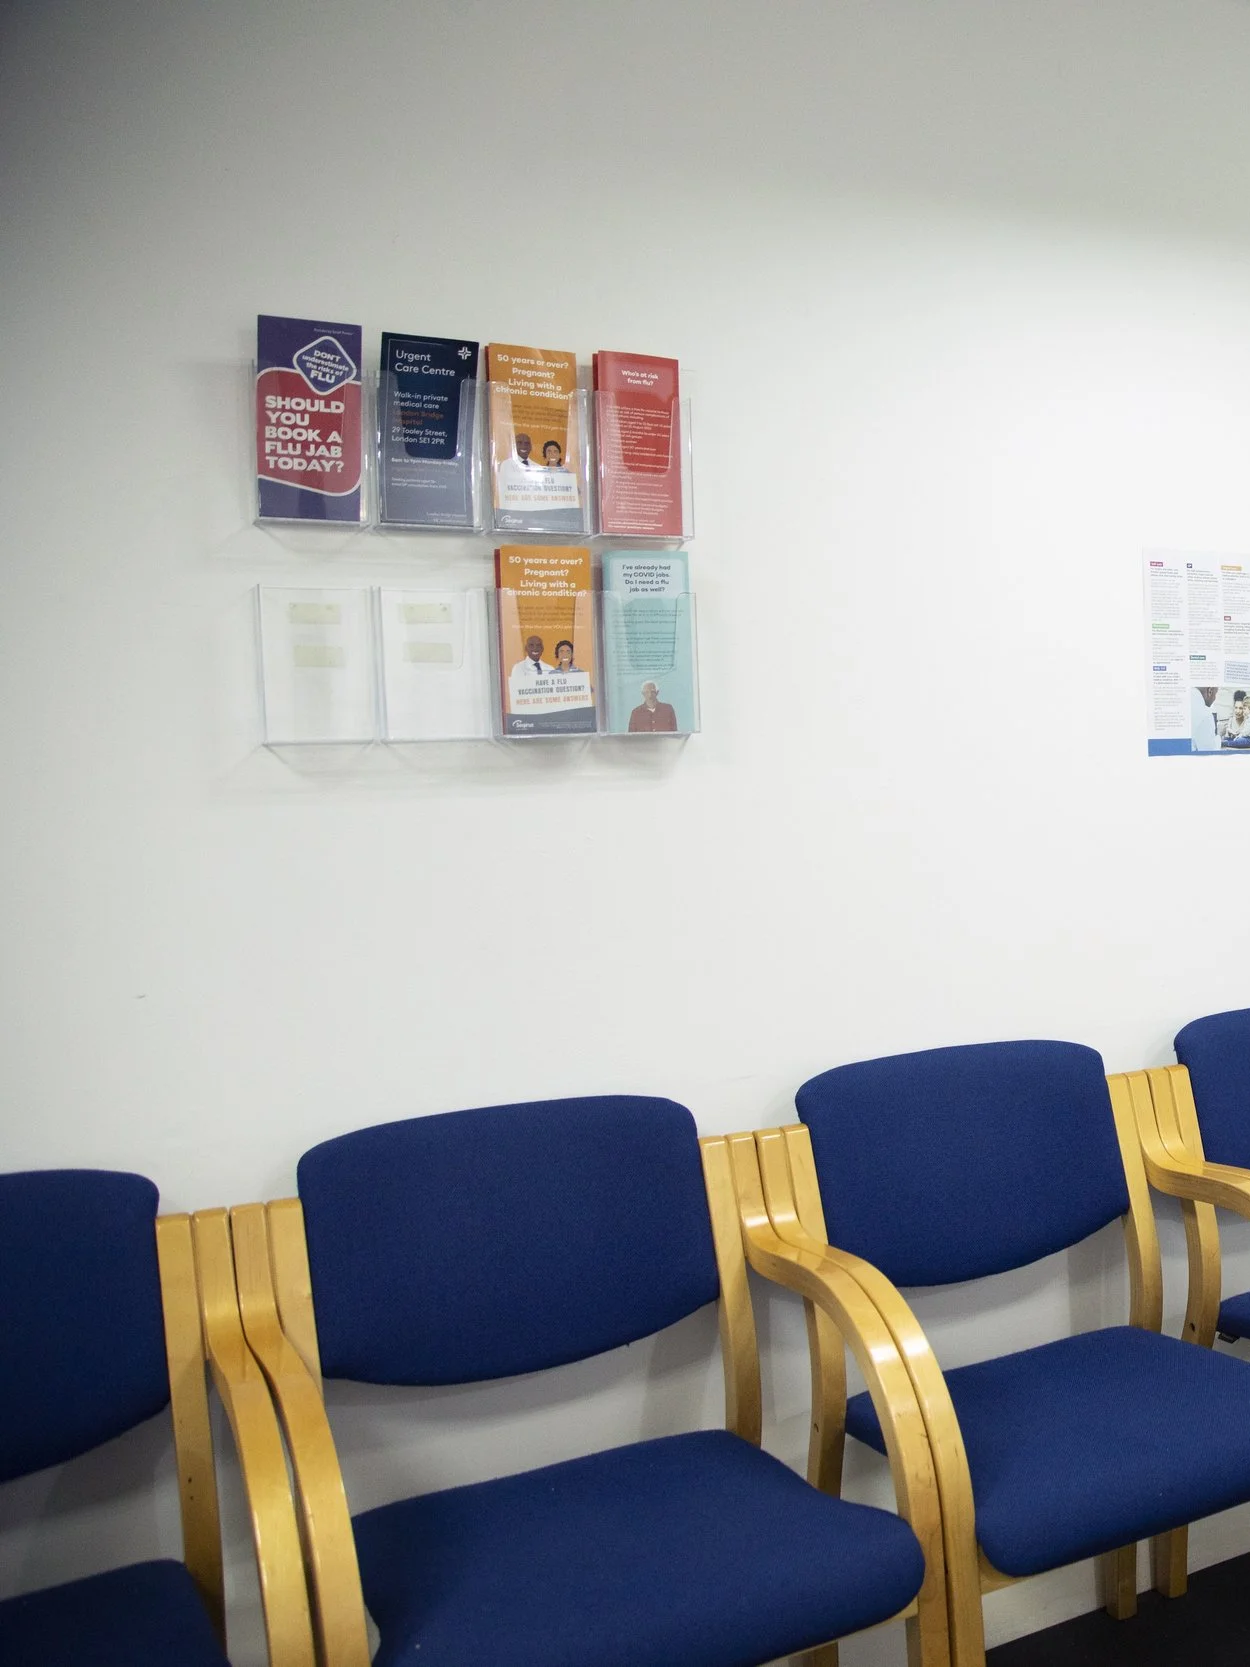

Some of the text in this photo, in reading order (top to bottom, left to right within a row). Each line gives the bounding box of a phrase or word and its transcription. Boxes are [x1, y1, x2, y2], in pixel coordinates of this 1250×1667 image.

[396, 349, 431, 362] Urgent
[497, 354, 508, 362] 50
[302, 355, 349, 371] underestimate
[318, 364, 334, 374] risks
[395, 363, 456, 376] Care Centre
[512, 367, 555, 379] Pregnant?
[310, 370, 336, 384] FLU
[508, 378, 535, 389] Living
[537, 382, 555, 390] with
[394, 391, 421, 399] Walk-in
[496, 386, 574, 400] chronic condition?
[265, 396, 345, 414] SHOULD
[266, 411, 310, 426] YOU
[265, 426, 343, 443] BOOK A
[402, 427, 423, 436] Tooley
[424, 429, 448, 437] Street,
[265, 441, 342, 458] FLU JAB
[266, 456, 344, 472] TODAY?
[524, 568, 569, 577] Pregnant?
[520, 580, 547, 589] Living
[507, 588, 540, 596] chronic
[518, 686, 553, 695] VACCINATION
